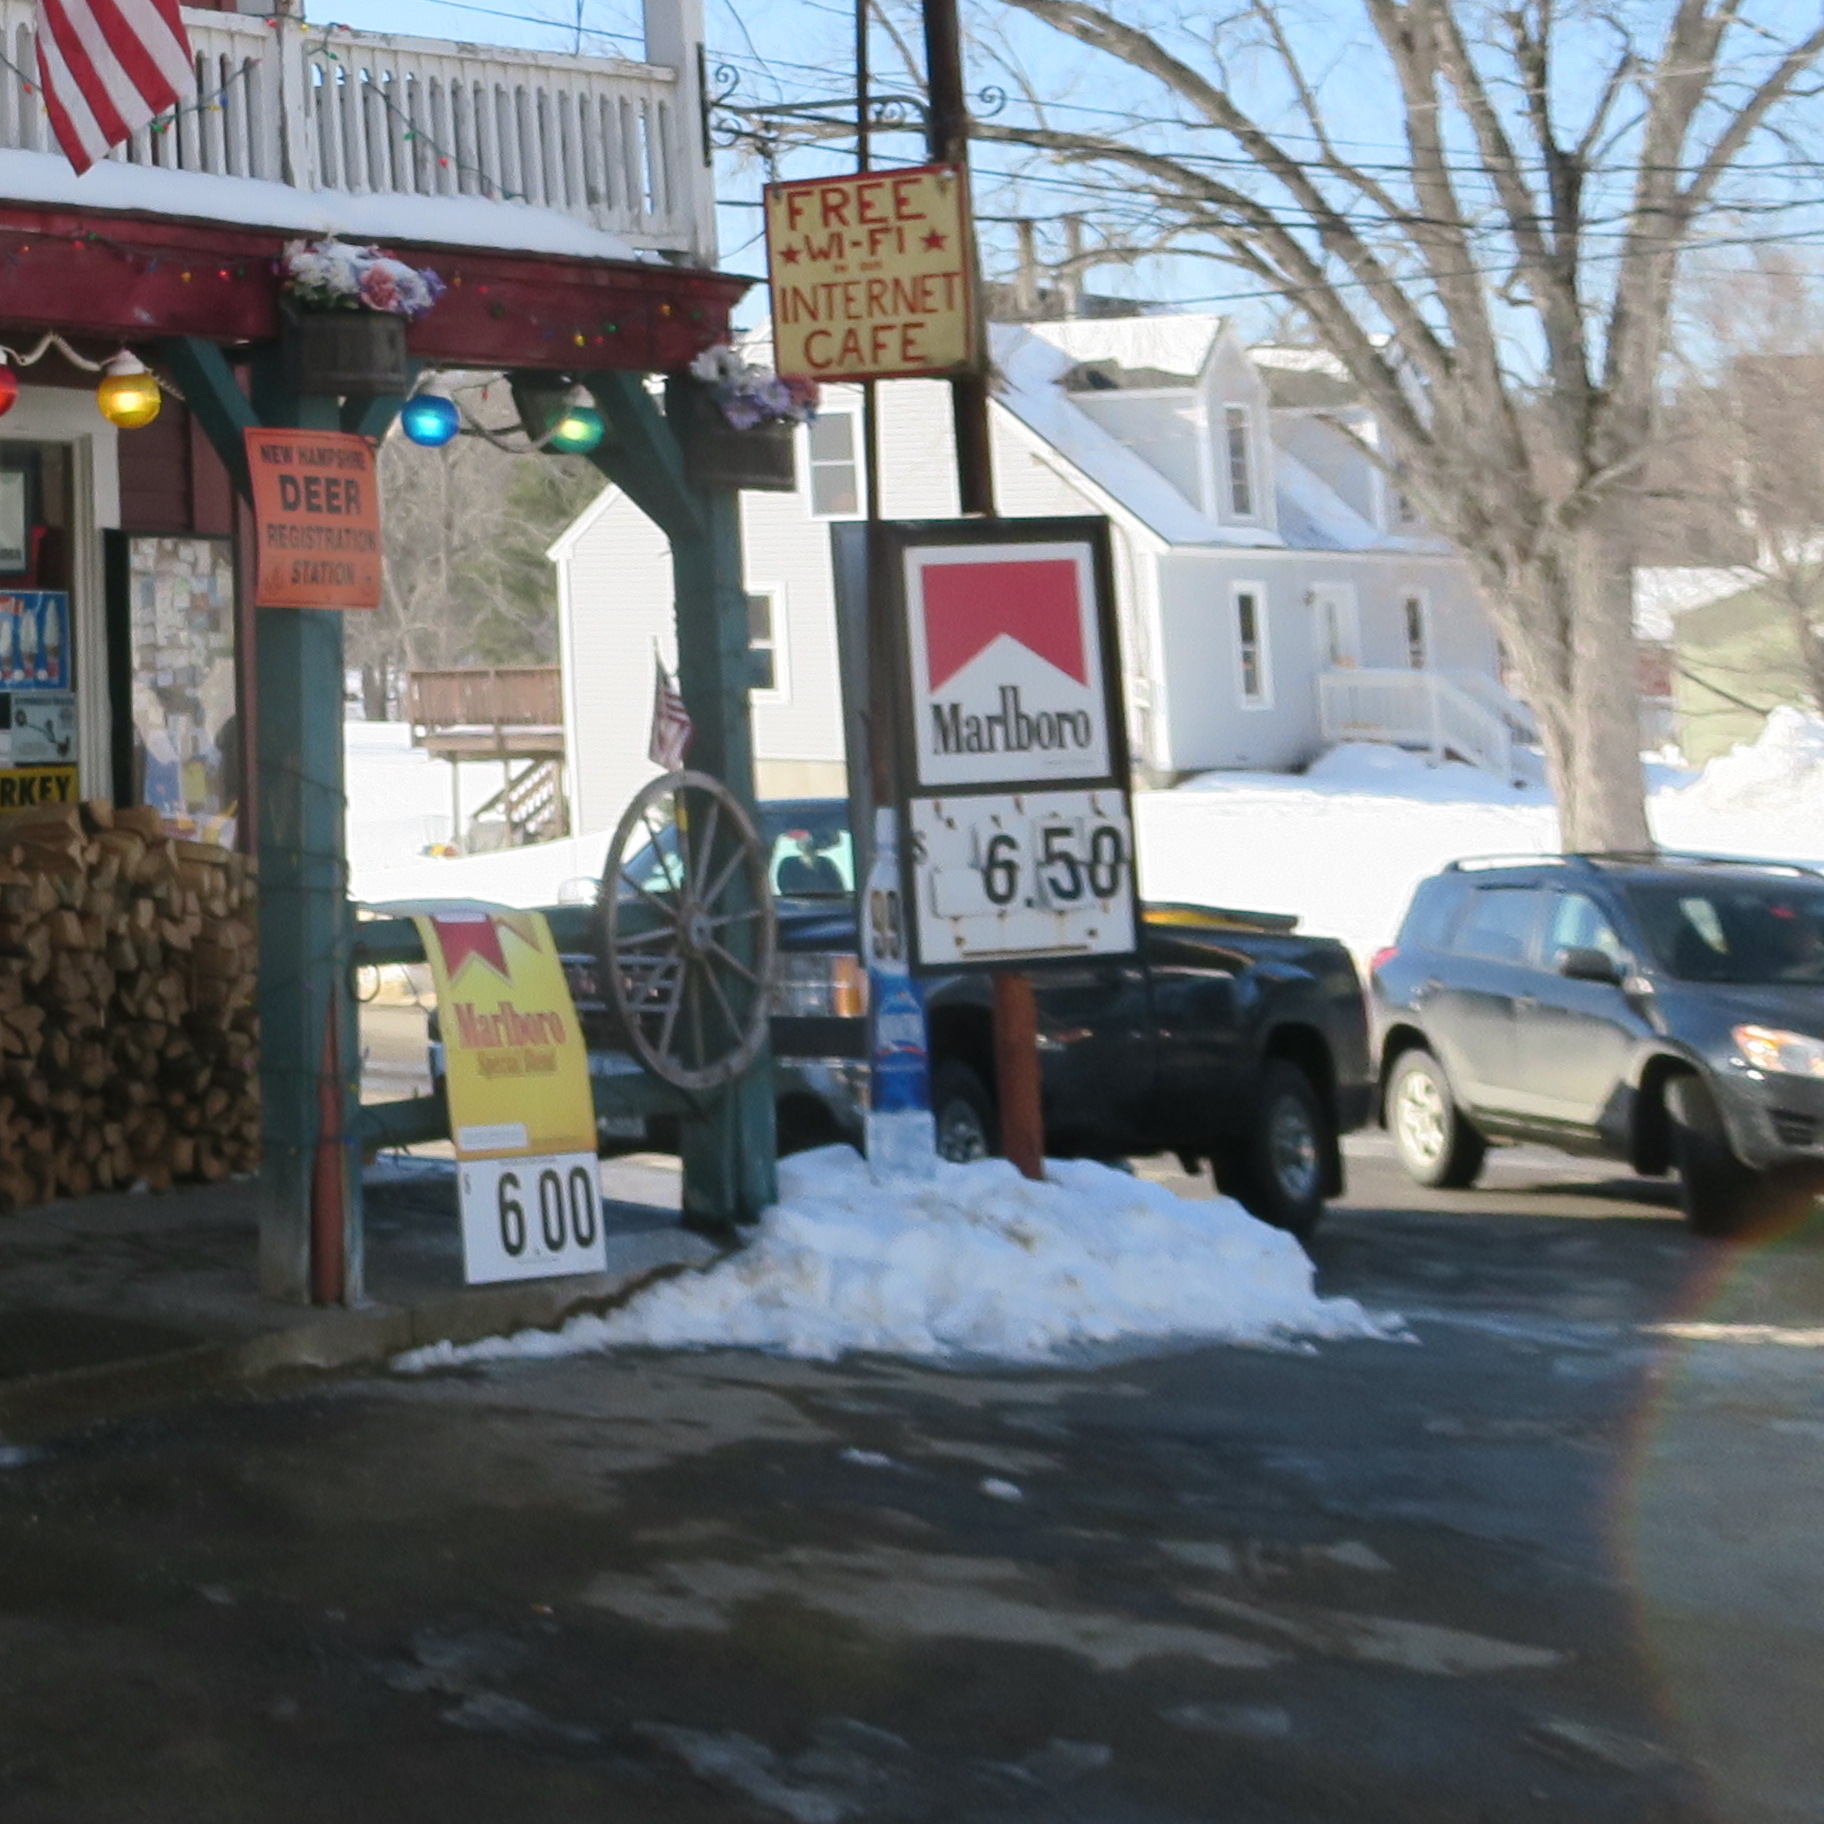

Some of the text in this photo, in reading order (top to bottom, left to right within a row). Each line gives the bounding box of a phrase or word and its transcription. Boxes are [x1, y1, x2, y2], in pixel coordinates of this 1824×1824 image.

[785, 177, 928, 231] FREE
[804, 226, 906, 262] WI-FI
[780, 272, 961, 325] INTERNET
[804, 321, 928, 371] CAFE
[260, 444, 366, 471] NEW HAMPSHIRE
[278, 474, 362, 516] DEER
[266, 523, 377, 552] REGISTRATION
[290, 559, 355, 586] STATION
[929, 684, 1092, 757] Marlboro
